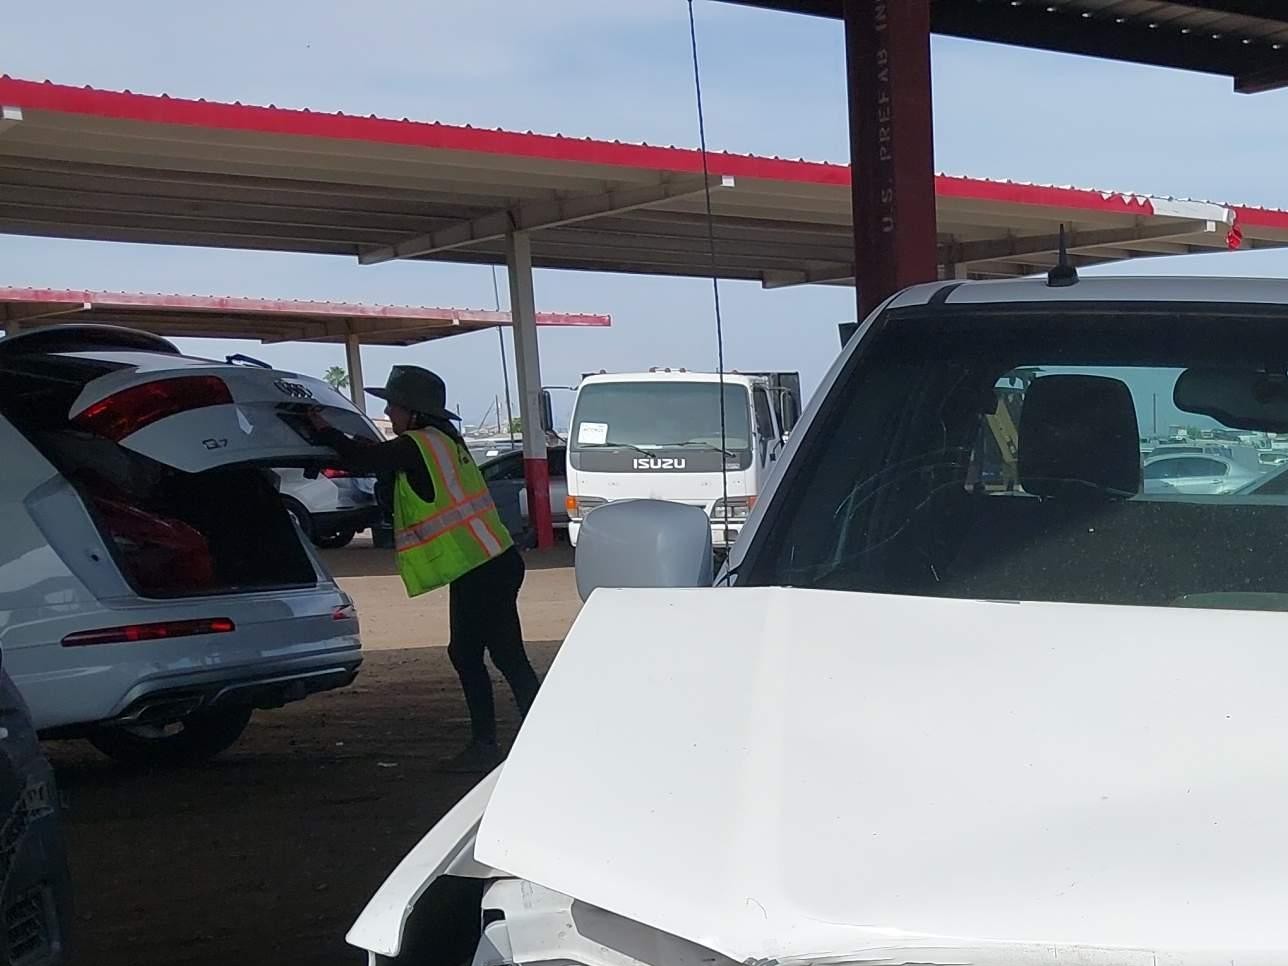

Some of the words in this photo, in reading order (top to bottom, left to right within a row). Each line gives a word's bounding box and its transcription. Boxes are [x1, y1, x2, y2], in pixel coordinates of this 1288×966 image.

[875, 0, 888, 32] IN
[877, 49, 892, 161] PREFAB
[632, 458, 686, 469] ISUZU
